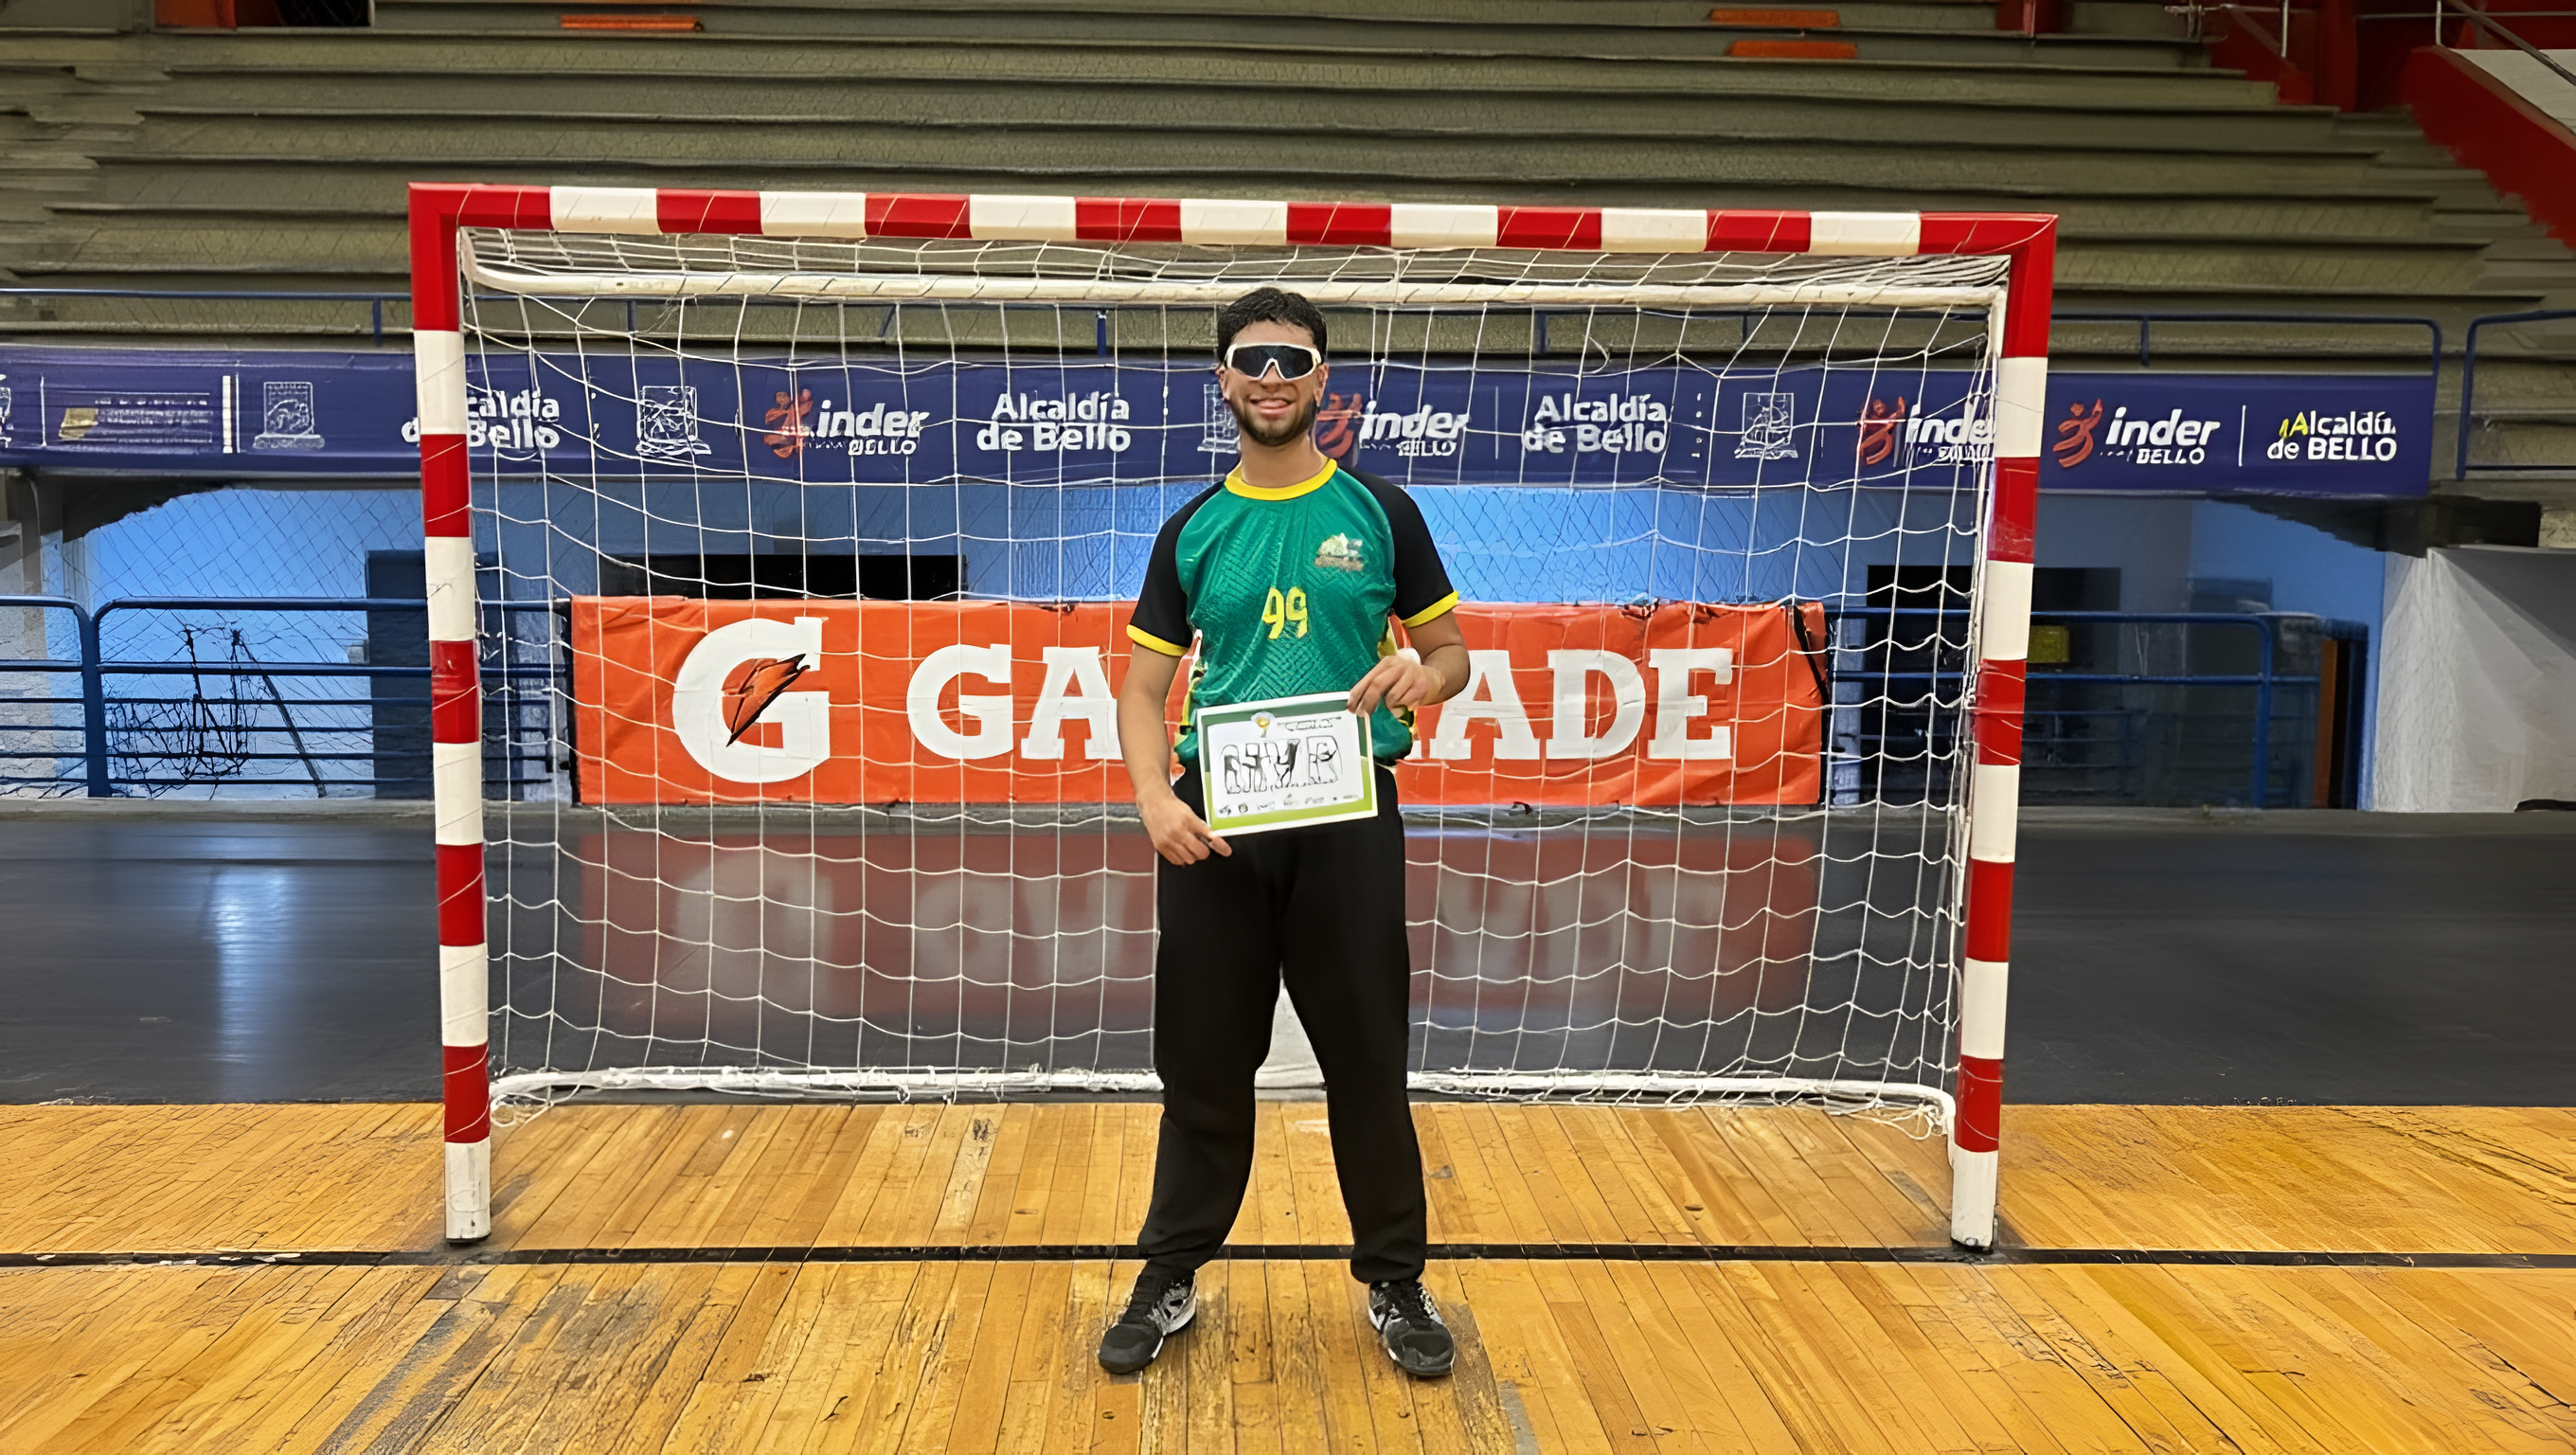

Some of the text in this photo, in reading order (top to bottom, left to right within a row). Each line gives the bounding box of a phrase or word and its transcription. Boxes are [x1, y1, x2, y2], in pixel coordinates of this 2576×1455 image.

[816, 399, 930, 438] inder
[991, 390, 1130, 422] Alcaldía
[1360, 400, 1469, 440] inder
[1534, 392, 1667, 422] Alcaldía
[976, 422, 1131, 453] de Bello
[1524, 422, 1666, 454] de Bello
[1905, 404, 1994, 444] inde
[2105, 406, 2221, 446] inder
[2136, 447, 2205, 464] BELLO
[2266, 437, 2398, 461] de BELLO
[1261, 586, 1309, 640] 99
[672, 616, 1733, 783] G GAADE
